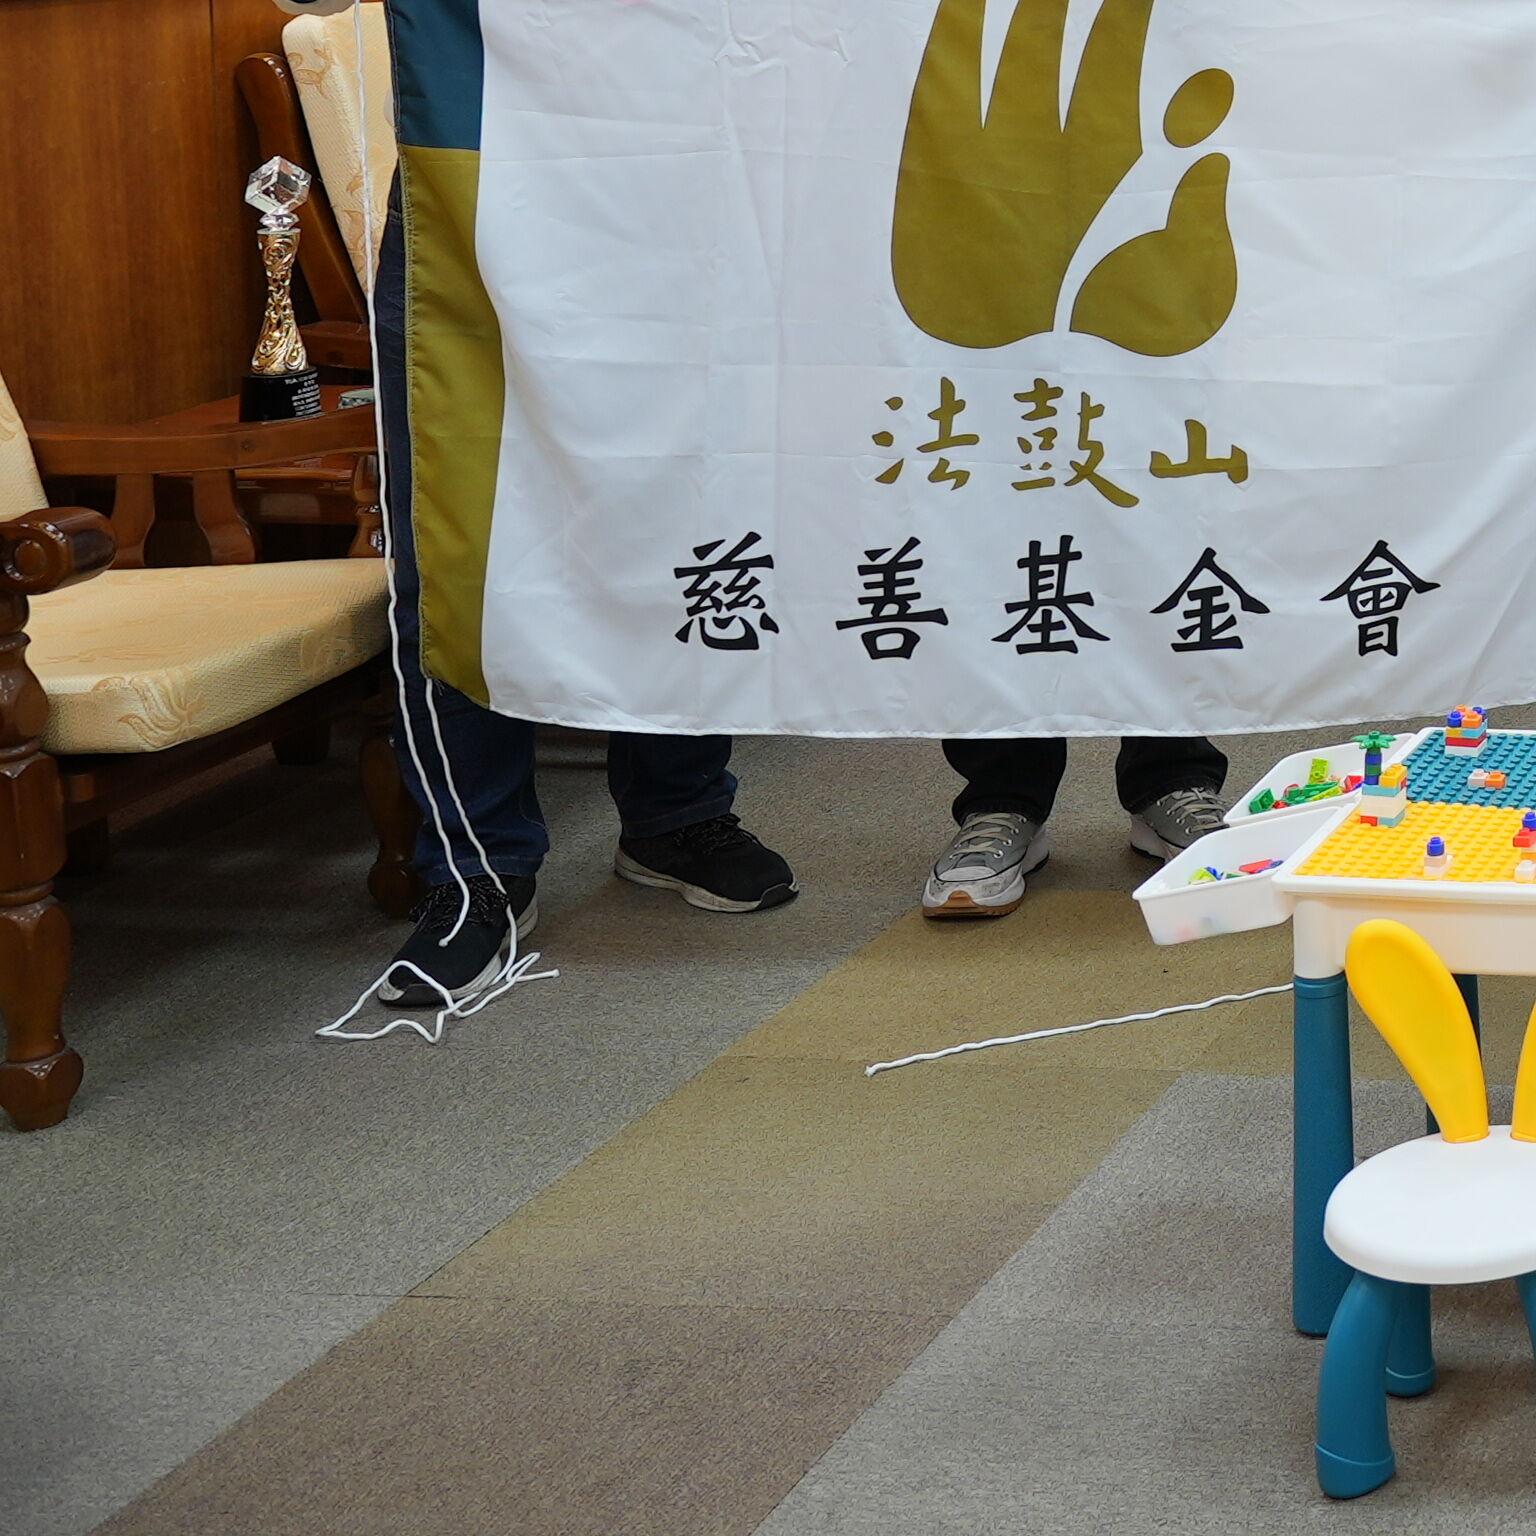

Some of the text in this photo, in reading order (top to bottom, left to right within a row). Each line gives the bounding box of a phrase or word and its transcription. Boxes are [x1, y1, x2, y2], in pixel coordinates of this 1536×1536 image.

[872, 375, 1250, 510] 法鼓山
[672, 531, 1442, 661] 慈善基金會
